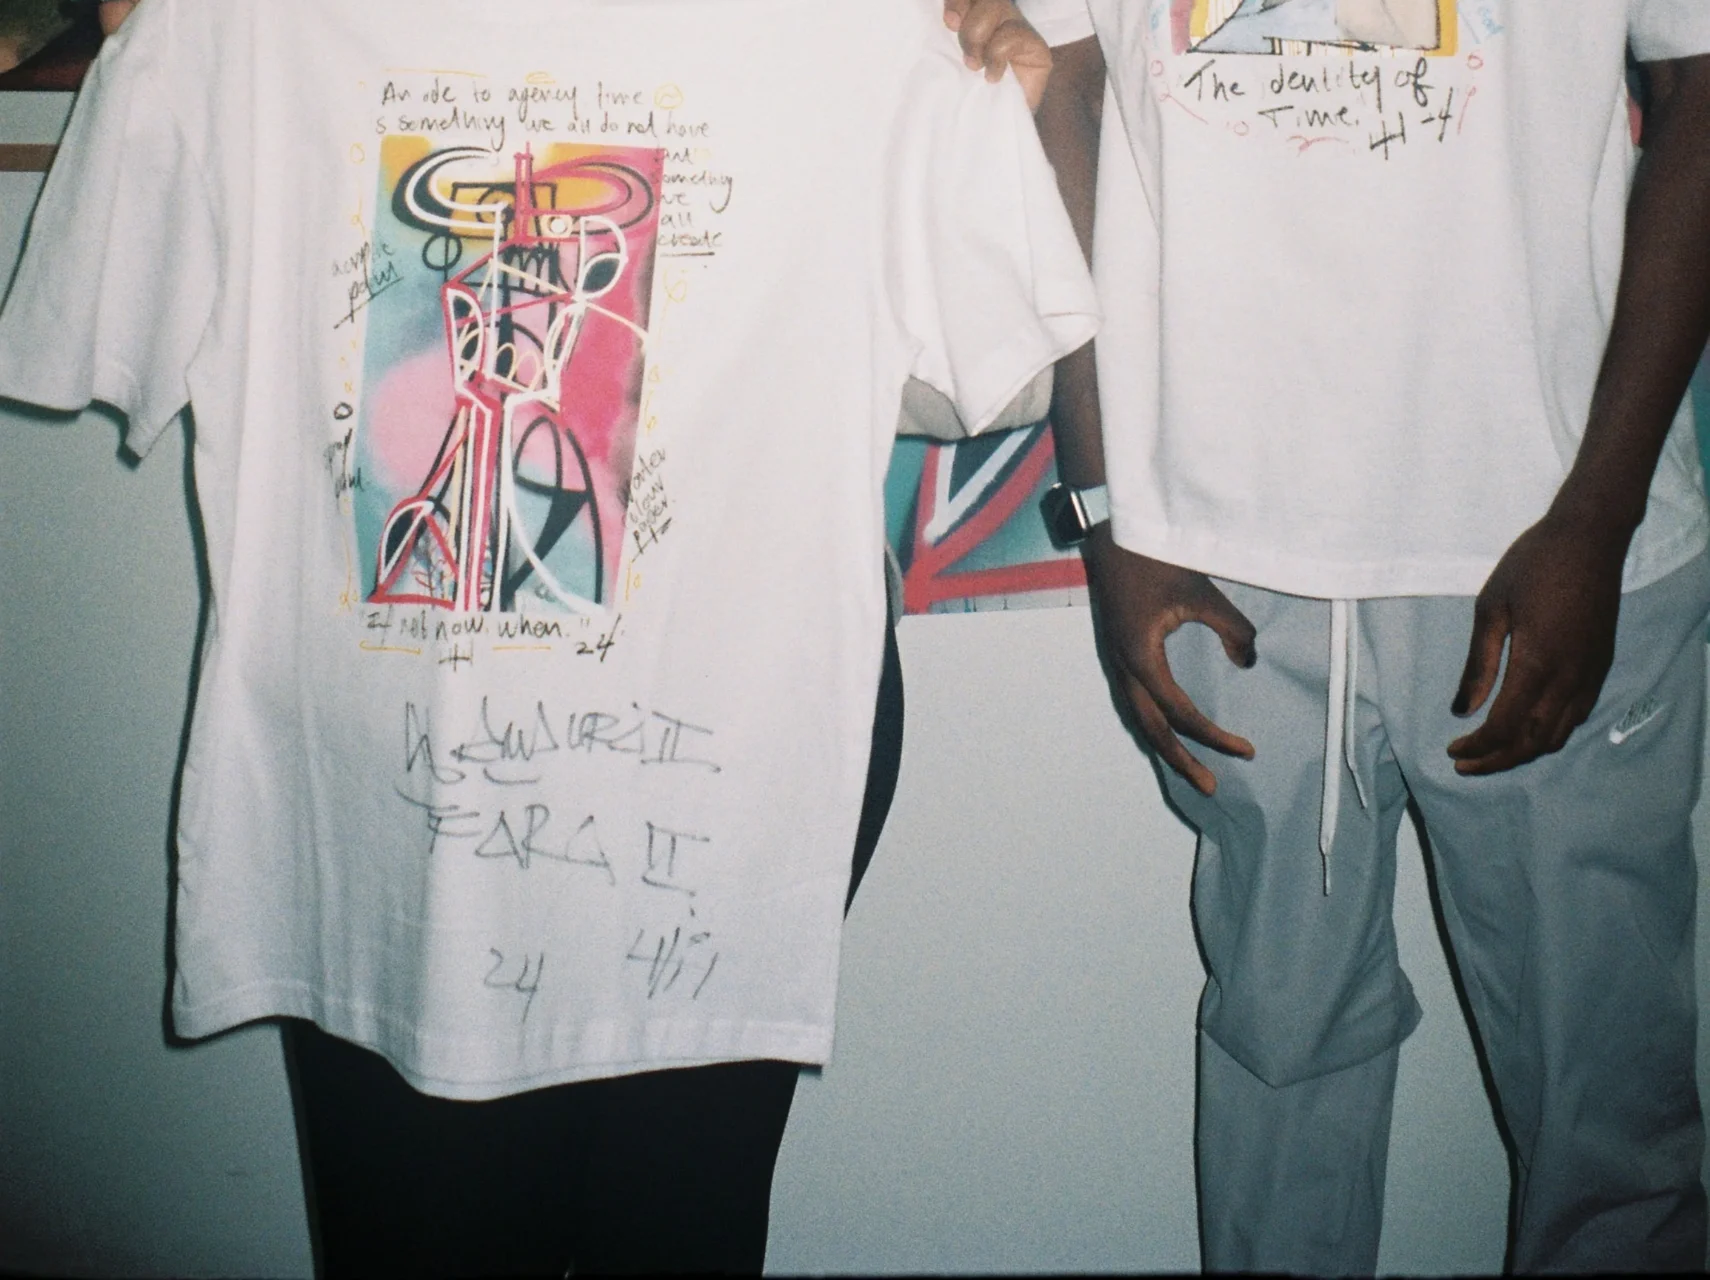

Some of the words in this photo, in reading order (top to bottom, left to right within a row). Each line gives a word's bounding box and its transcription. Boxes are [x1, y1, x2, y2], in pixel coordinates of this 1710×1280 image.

[381, 81, 411, 106] An
[423, 77, 457, 104] ode
[473, 81, 491, 103] to
[1184, 59, 1245, 102] The
[1396, 57, 1434, 107] of
[526, 119, 556, 133] we
[567, 118, 591, 134] all
[600, 111, 619, 133] do
[627, 111, 658, 138] not
[666, 111, 710, 137] have
[660, 211, 692, 228] all
